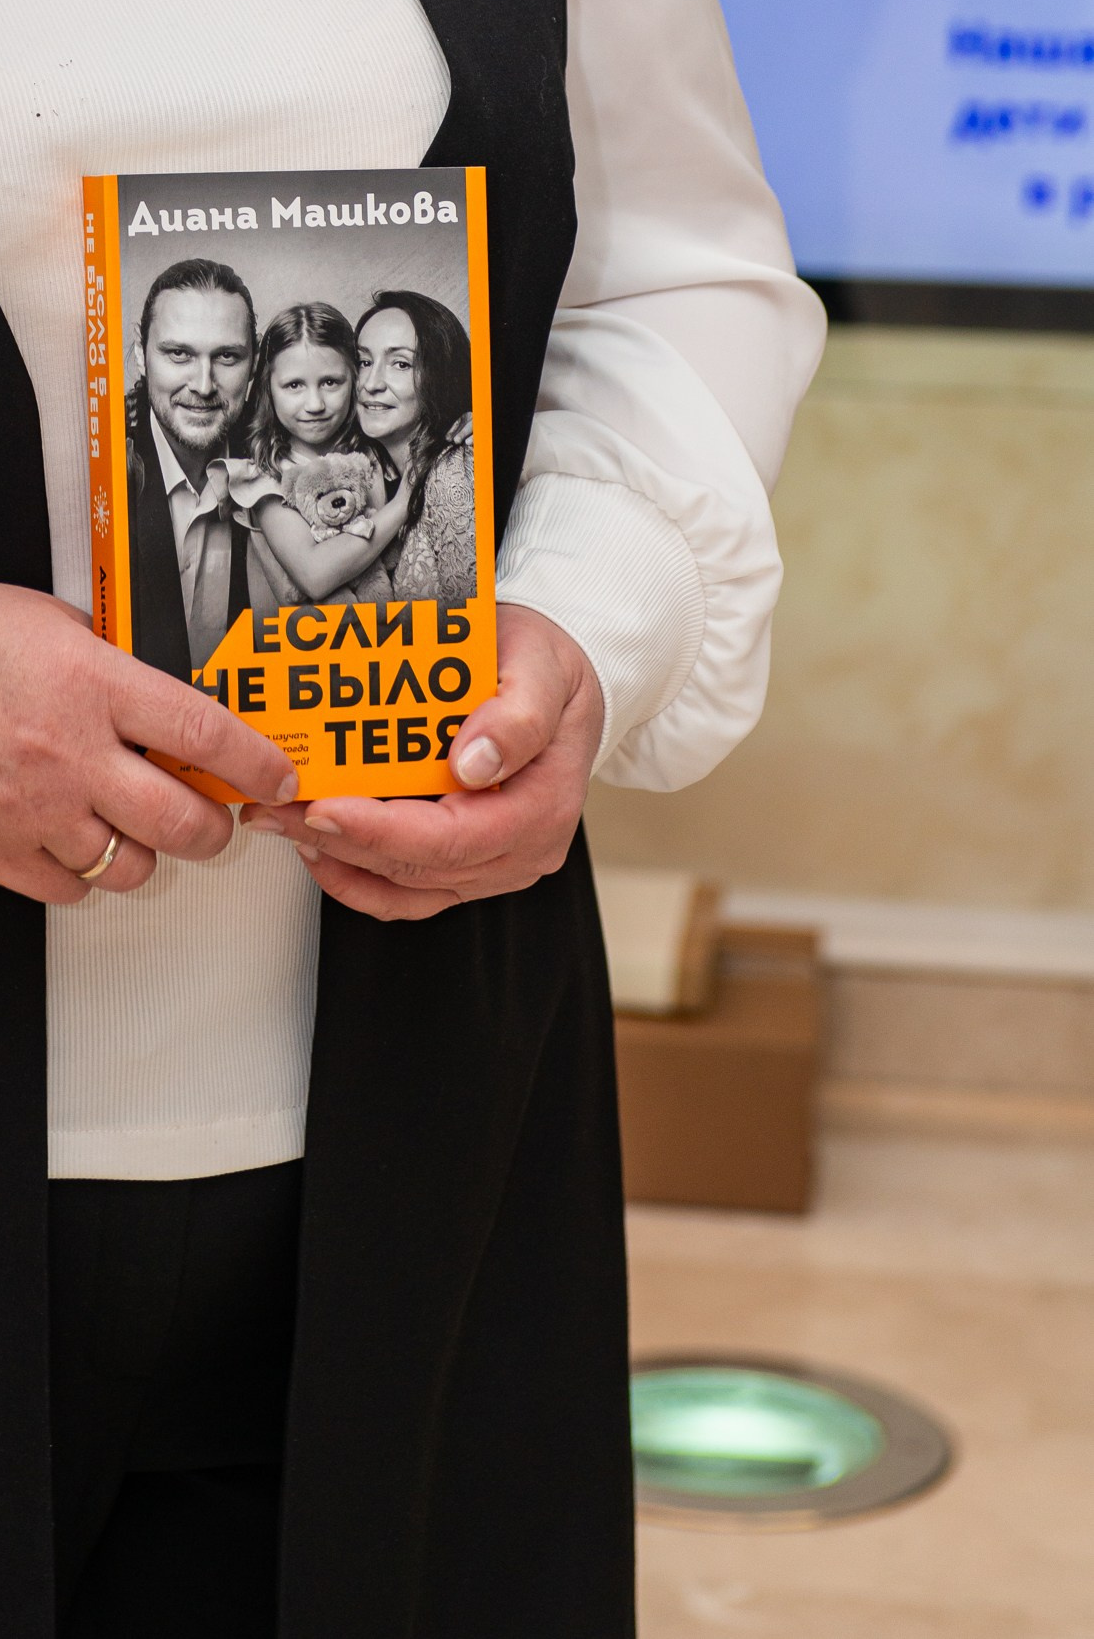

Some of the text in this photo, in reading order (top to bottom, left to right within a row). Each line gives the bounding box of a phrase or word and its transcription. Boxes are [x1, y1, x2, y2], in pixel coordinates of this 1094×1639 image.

[128, 191, 459, 237] Диана Машкова
[86, 213, 100, 458] НЕ БЫЛО ТЕБЯ
[96, 276, 107, 397] ЕСЛИ Б
[252, 600, 471, 654] ЕСЛИ Б
[193, 657, 471, 713] НЕ БЫЛО
[272, 732, 309, 743] изучать
[324, 714, 470, 766] ТЕБЯ
